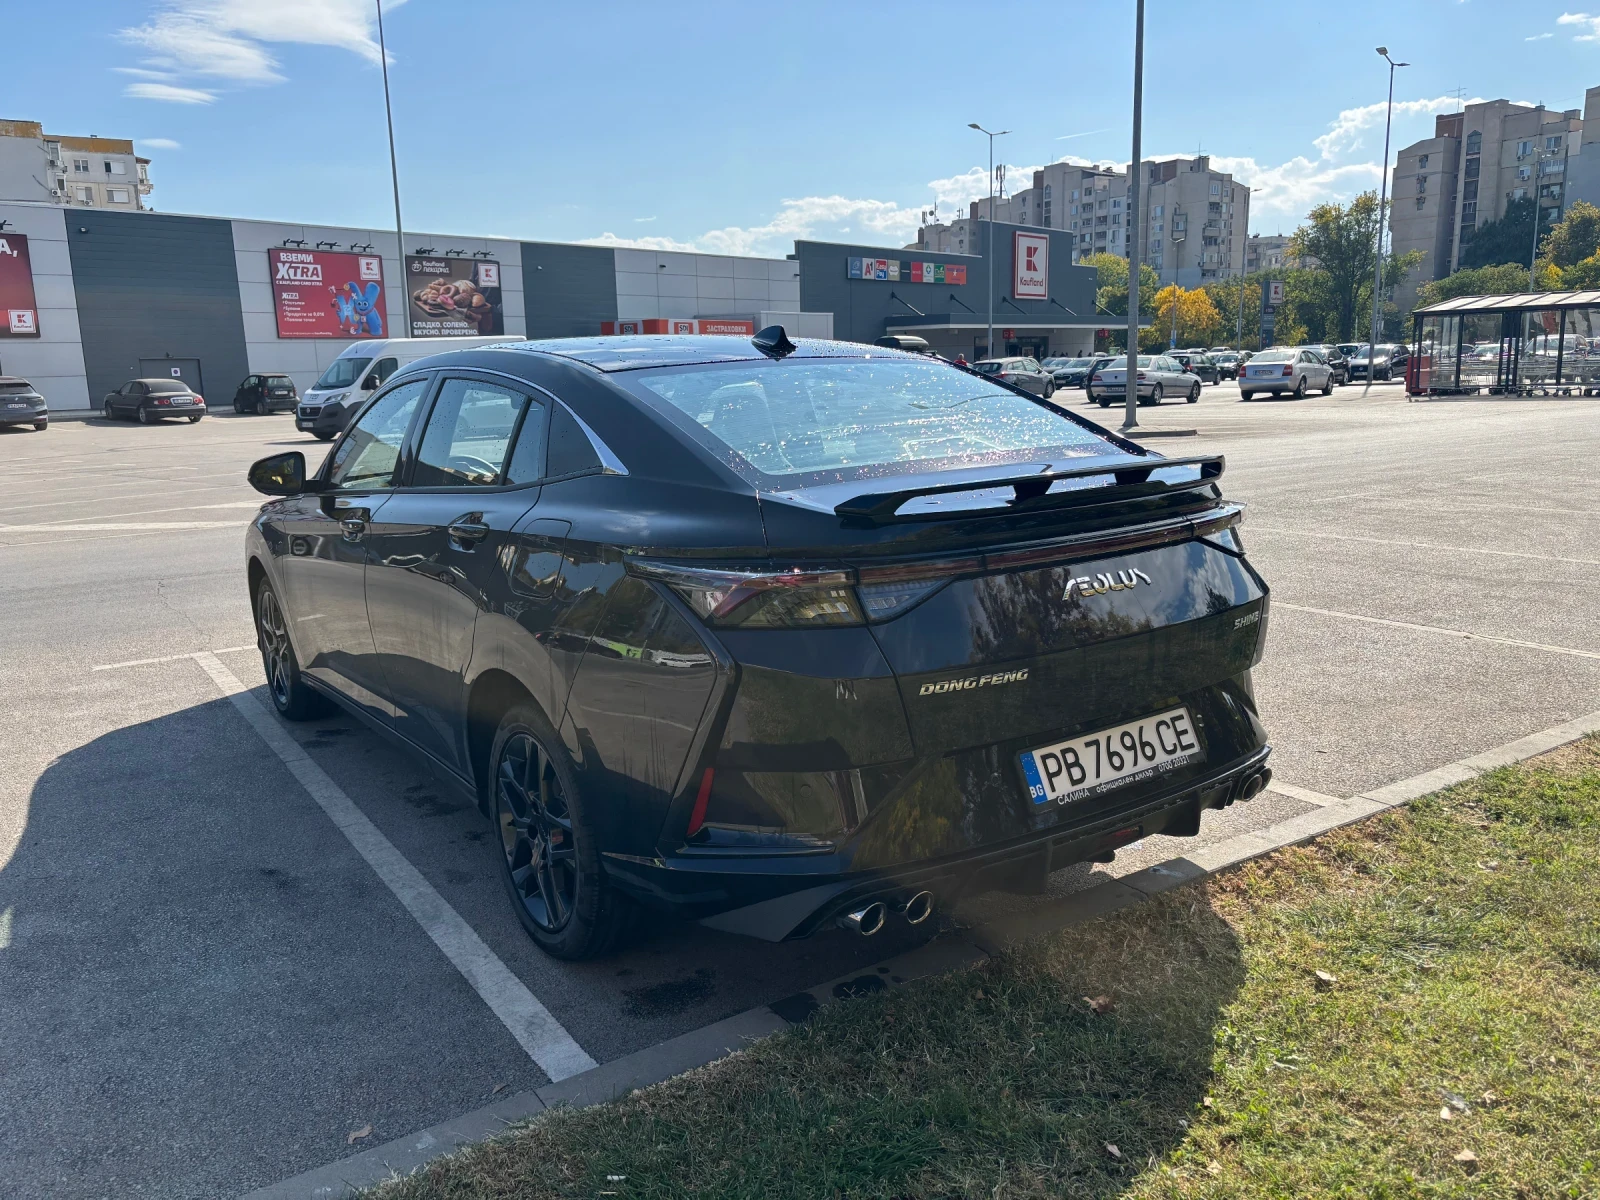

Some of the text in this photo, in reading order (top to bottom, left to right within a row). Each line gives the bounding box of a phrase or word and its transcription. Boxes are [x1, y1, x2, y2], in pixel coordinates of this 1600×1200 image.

[280, 252, 314, 263] ВЗЕМИ
[276, 263, 322, 280] XTRA
[864, 261, 873, 276] A1
[1020, 277, 1043, 287] Kaufland
[413, 321, 442, 329] СЛАДКО.
[624, 324, 634, 333] SDI
[679, 323, 688, 332] SDI
[706, 324, 747, 333] ЗАСТРАХОВКИ
[1233, 611, 1260, 631] SHINE
[1057, 787, 1091, 805] САЛИНА
[1096, 776, 1135, 794] официален
[1158, 760, 1173, 772] 0700
[1029, 784, 1045, 799] BG
